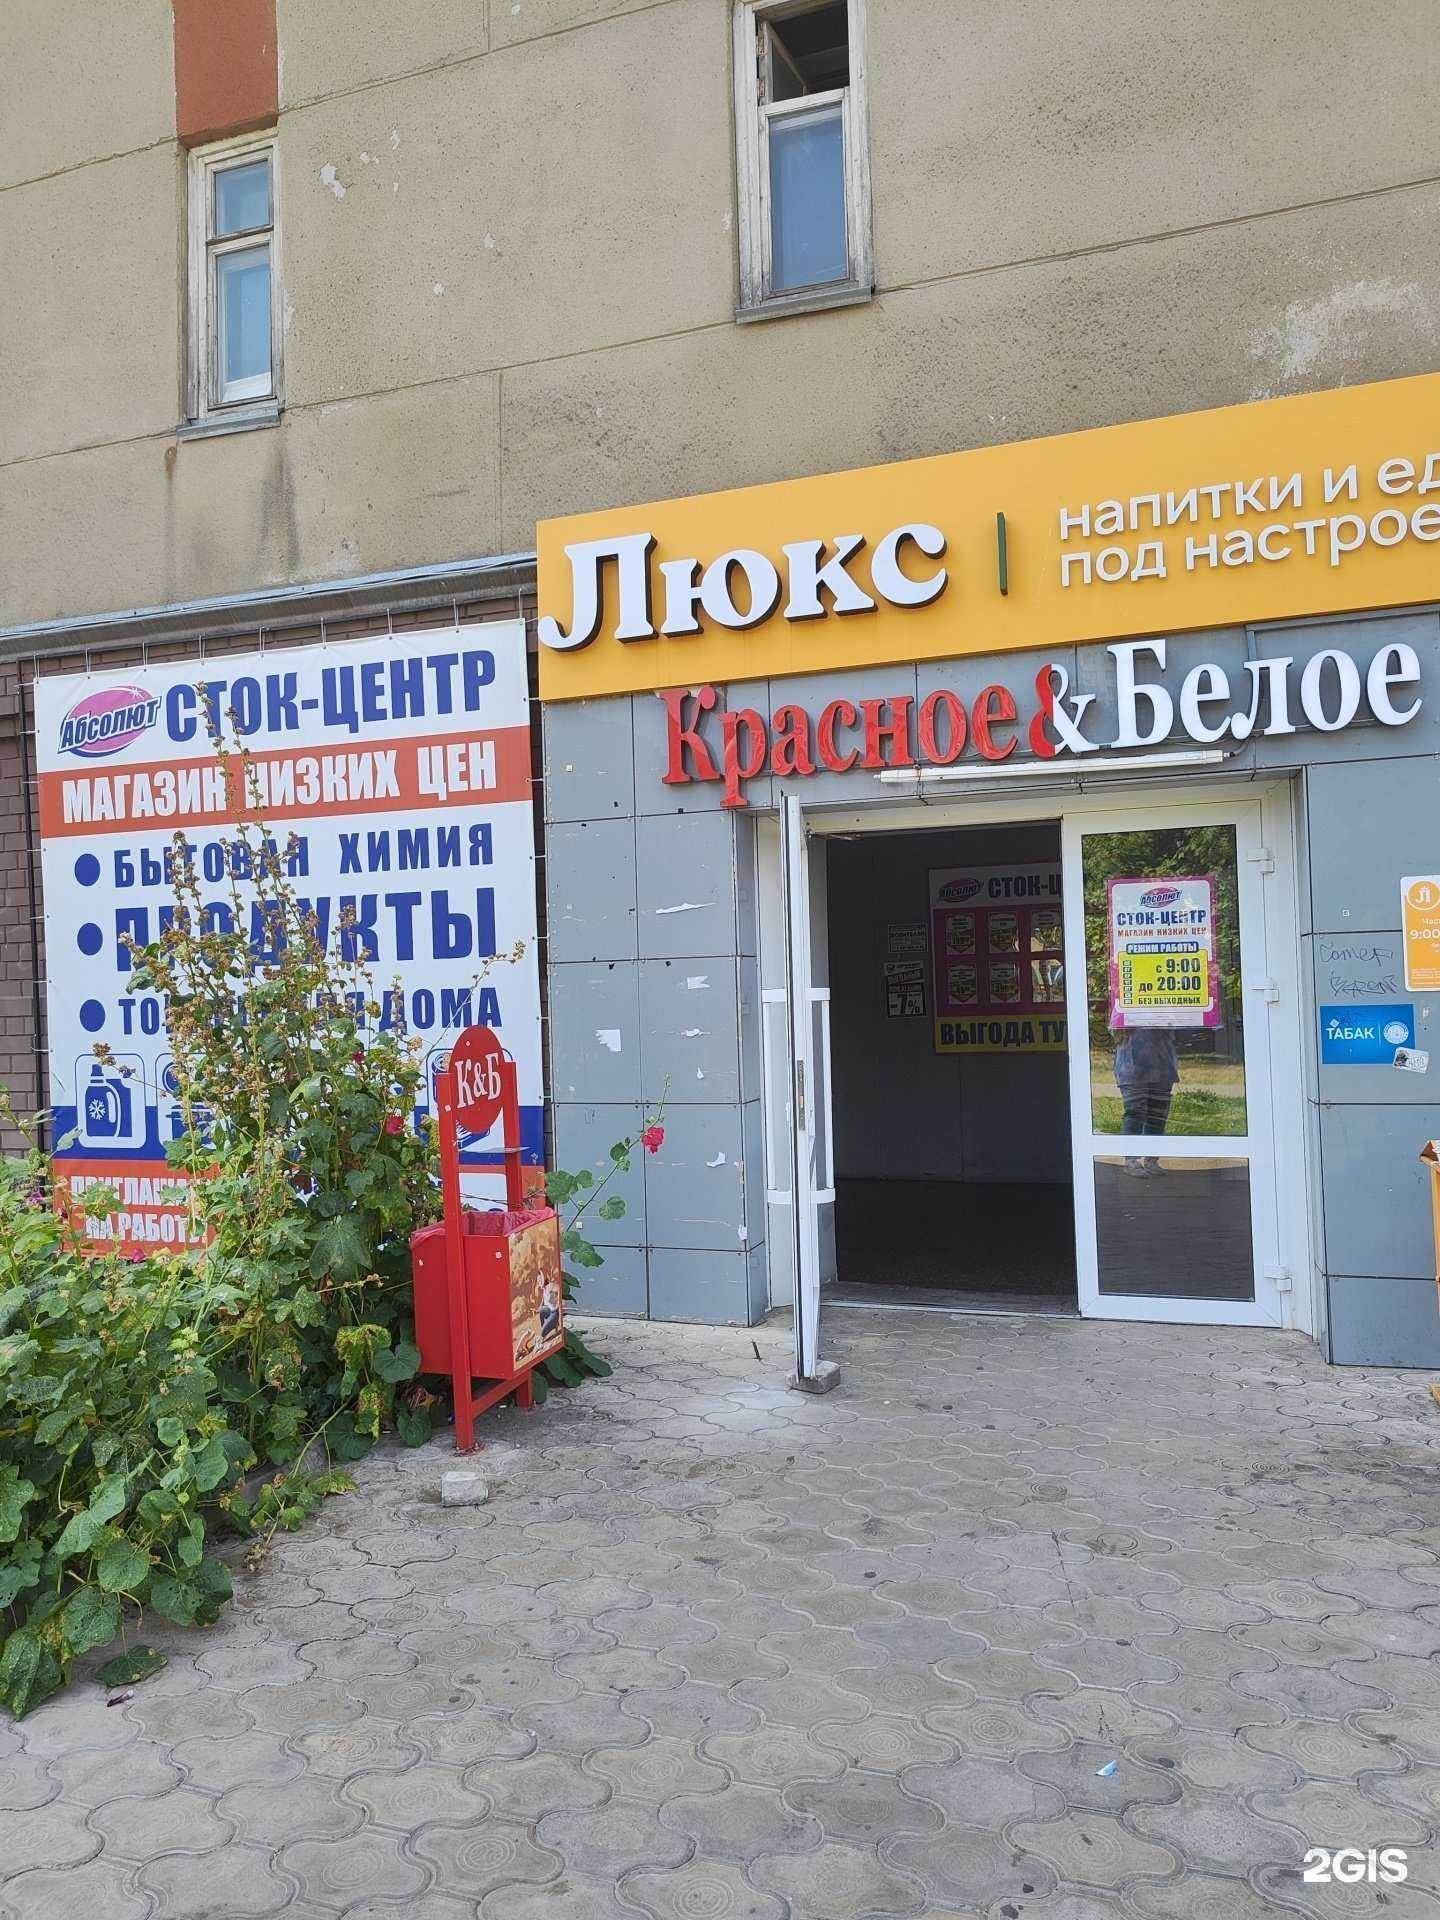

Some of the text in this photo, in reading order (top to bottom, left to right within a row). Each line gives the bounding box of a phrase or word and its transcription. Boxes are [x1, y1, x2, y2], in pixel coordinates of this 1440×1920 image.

[1059, 452, 1440, 540] напитки и ед
[1061, 503, 1440, 587] под настрое
[537, 523, 949, 652] Люкс
[166, 650, 496, 742] СТОК-ЦЕНТР
[59, 696, 161, 752] Абсолют
[62, 741, 496, 824] МАГАЗИН НИЗКИХ ЦЕН
[114, 823, 493, 888] БЫТОВАЯ ХИМИЯ
[988, 875, 1062, 898] СТОК-Ц
[1117, 910, 1206, 926] СТОК-ЦЕНТР
[1118, 929, 1154, 937] МАГАЗИН
[1128, 943, 1197, 953] РЕЖИМ РАБОТЫ
[1166, 958, 1201, 973] 9:00
[1138, 995, 1201, 1004] БЕЗ ВЫХОДНЫХ
[1139, 976, 1201, 992] до 20:00
[379, 987, 502, 1035] ДОМА
[940, 1020, 1067, 1047] ВЫГОДА ТУ
[1326, 1027, 1375, 1040] ТАБАК
[456, 1053, 502, 1109] К&Б
